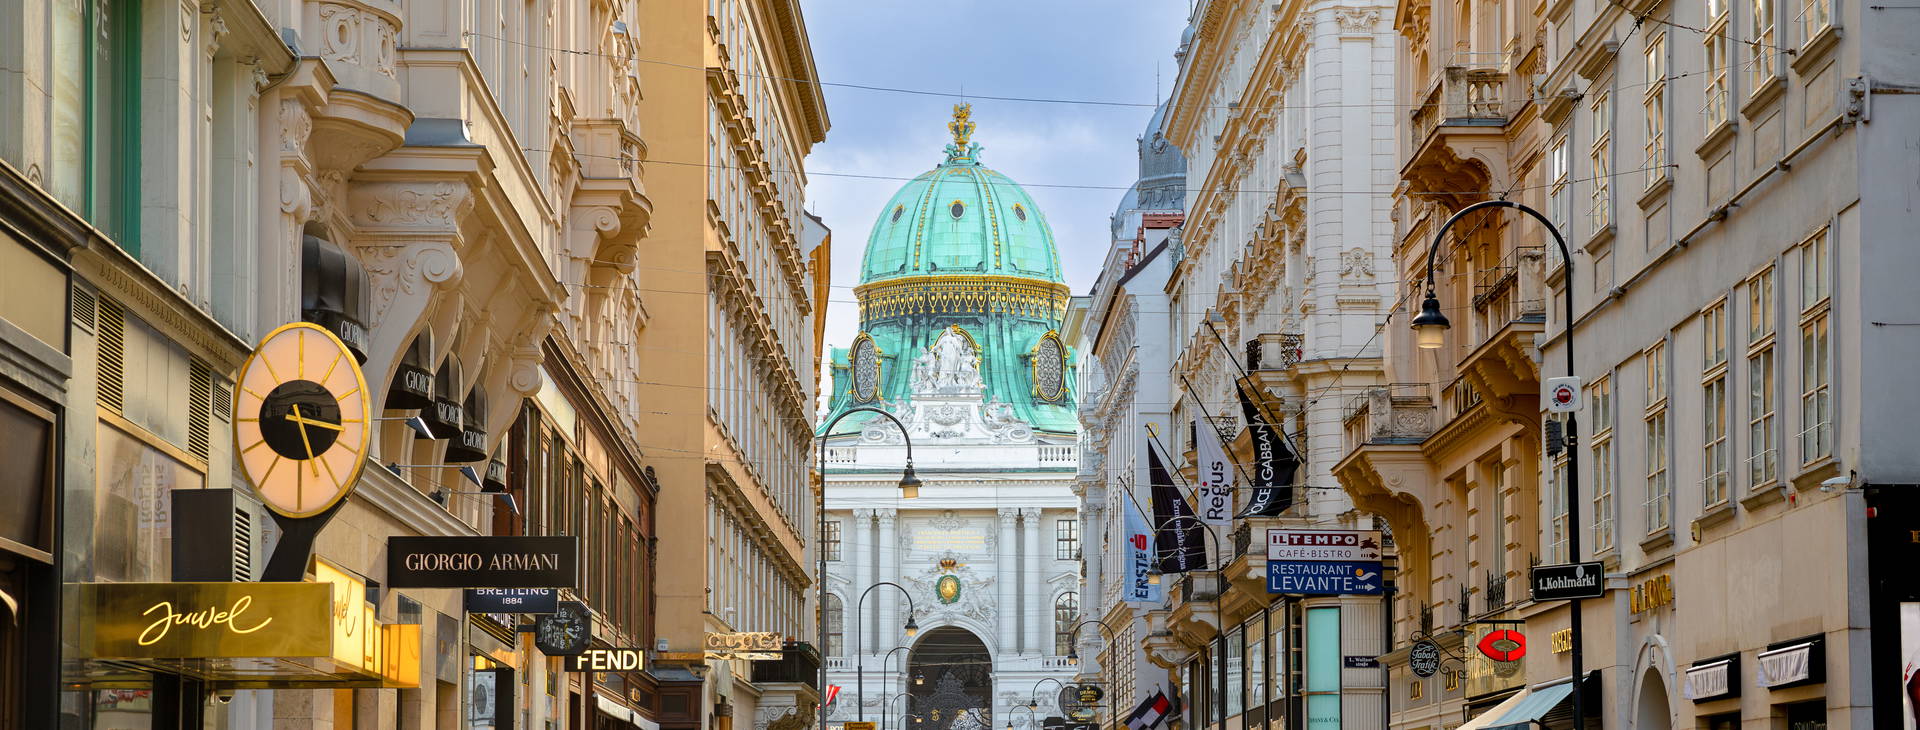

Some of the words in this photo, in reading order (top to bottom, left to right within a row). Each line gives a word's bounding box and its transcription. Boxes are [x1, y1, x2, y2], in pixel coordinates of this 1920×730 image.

[1252, 412, 1274, 481] GABBANA
[1206, 460, 1230, 520] Regus
[1290, 535, 1356, 545] TEMPO
[405, 553, 483, 571] GIORGIO
[488, 553, 560, 571] ARMANI
[1272, 564, 1353, 575] RESTAURANT
[1135, 551, 1149, 599] ERSTE
[1272, 576, 1353, 591] LEVANTE
[476, 588, 549, 596] BREITLING
[138, 595, 273, 646] Juwel
[577, 649, 643, 670] FENDI
[1412, 649, 1438, 660] Tabak
[1412, 660, 1438, 670] Trafik
